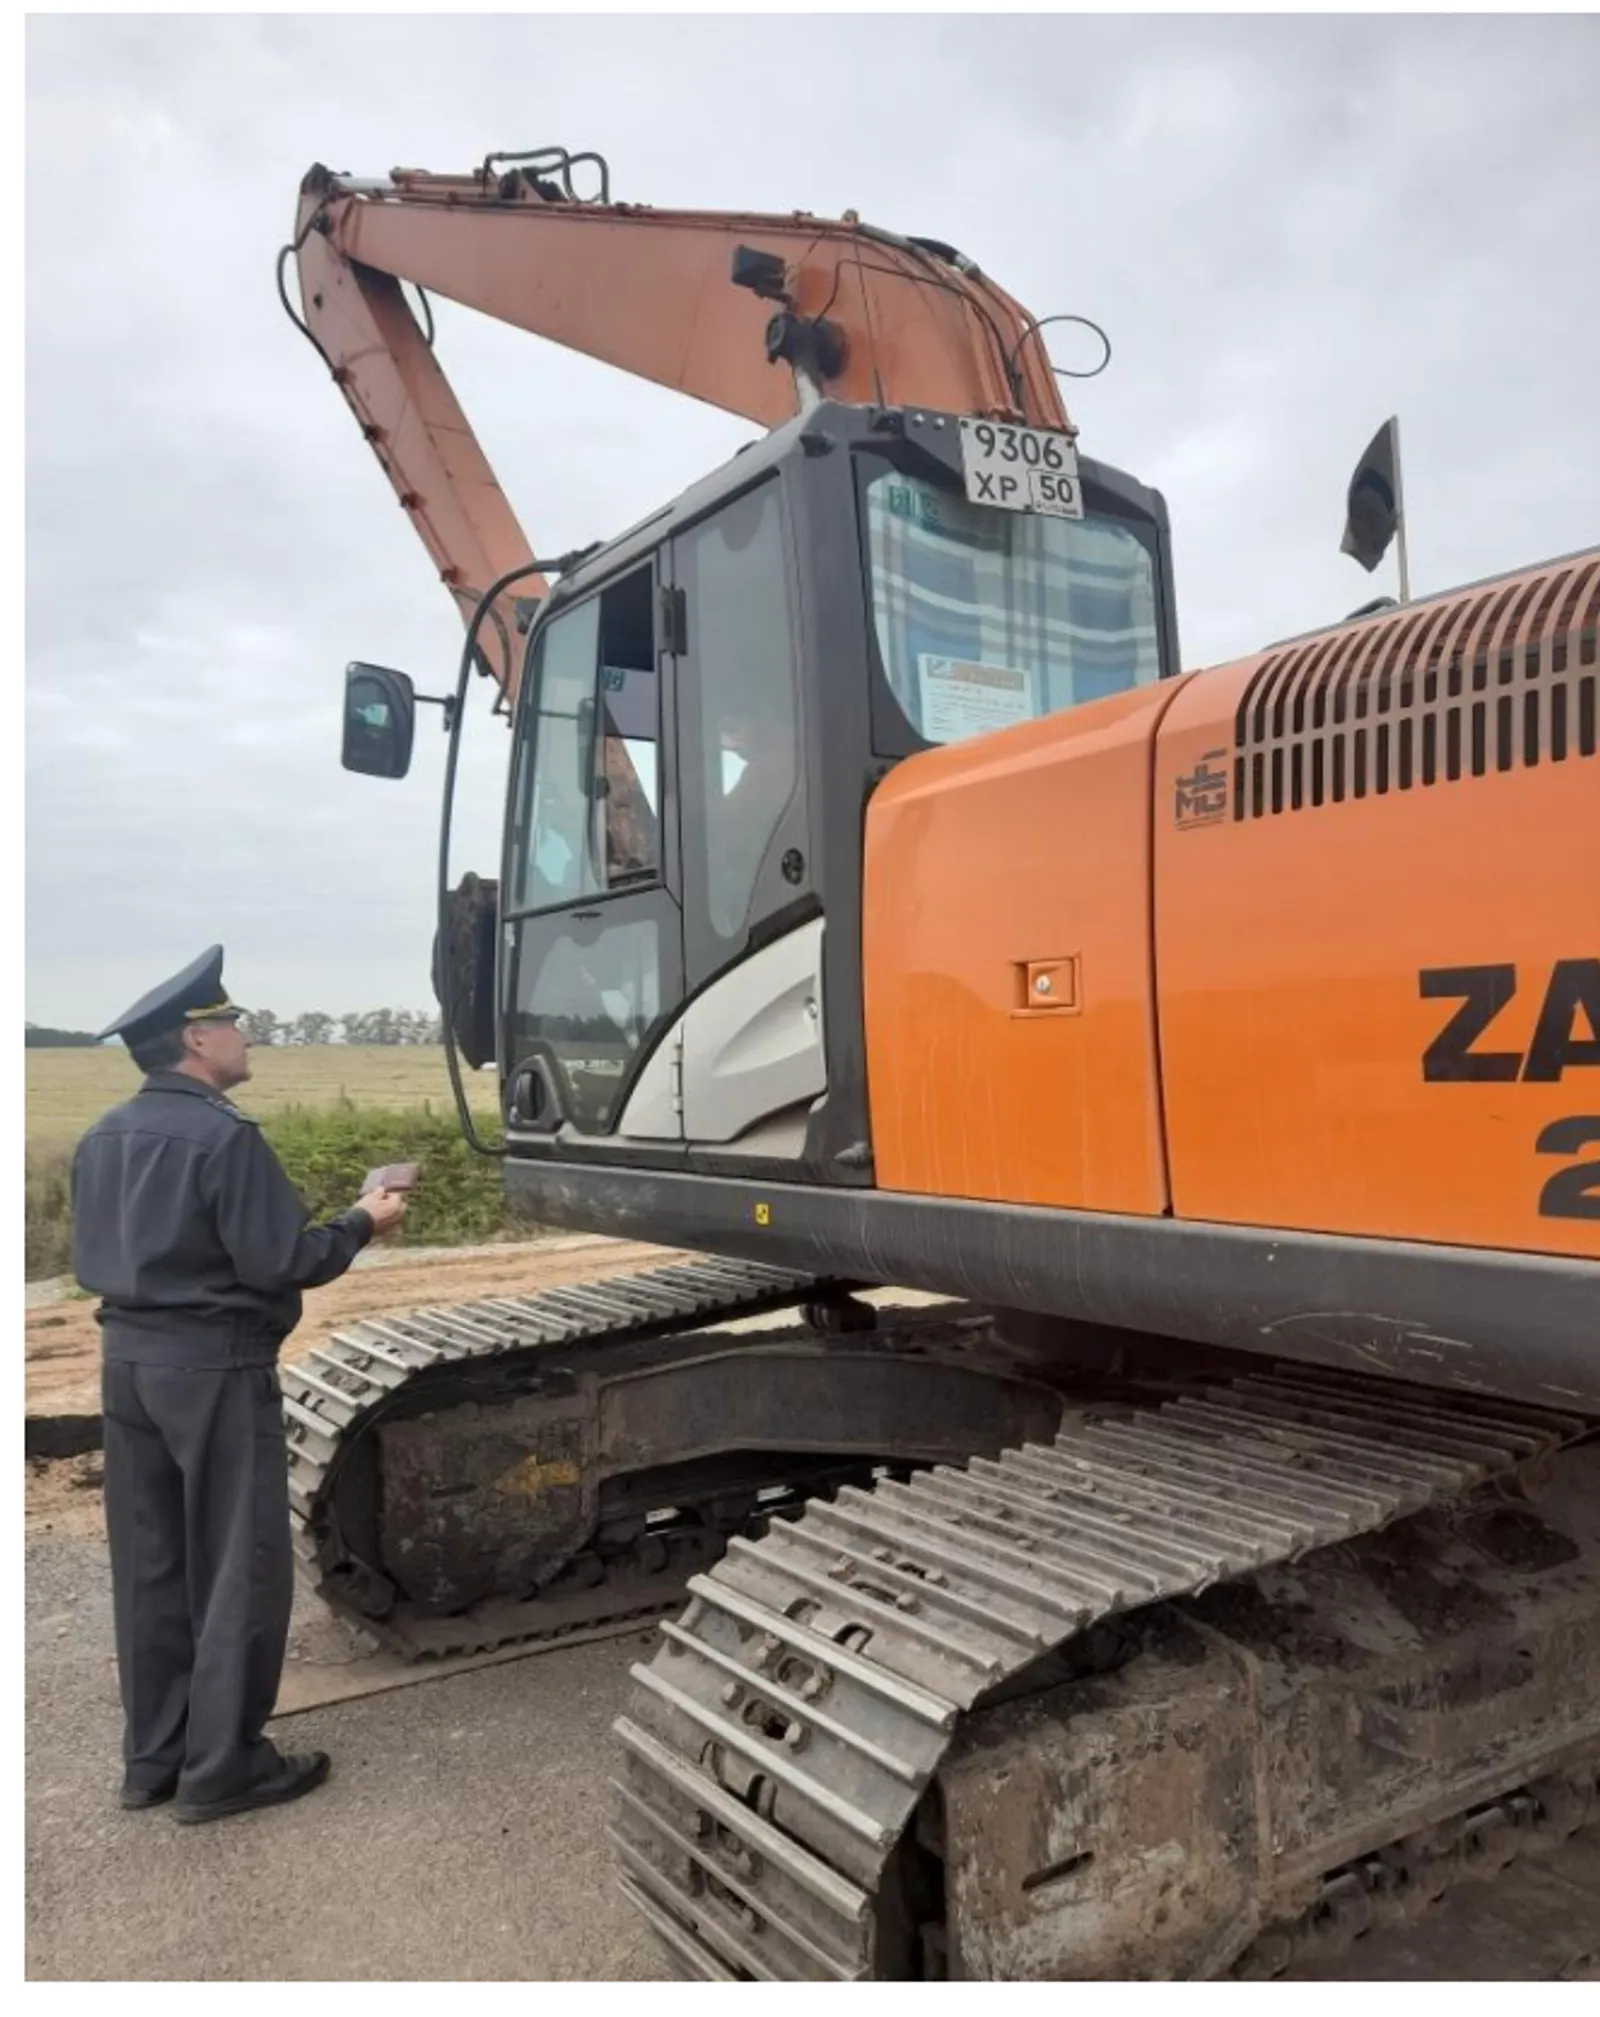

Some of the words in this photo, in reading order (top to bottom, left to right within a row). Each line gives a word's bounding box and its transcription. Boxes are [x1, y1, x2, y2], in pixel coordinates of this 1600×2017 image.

[975, 424, 1063, 469] 9306
[1040, 475, 1073, 503] 50
[1419, 957, 1600, 1082] ZA
[1535, 1114, 1600, 1221] 2
